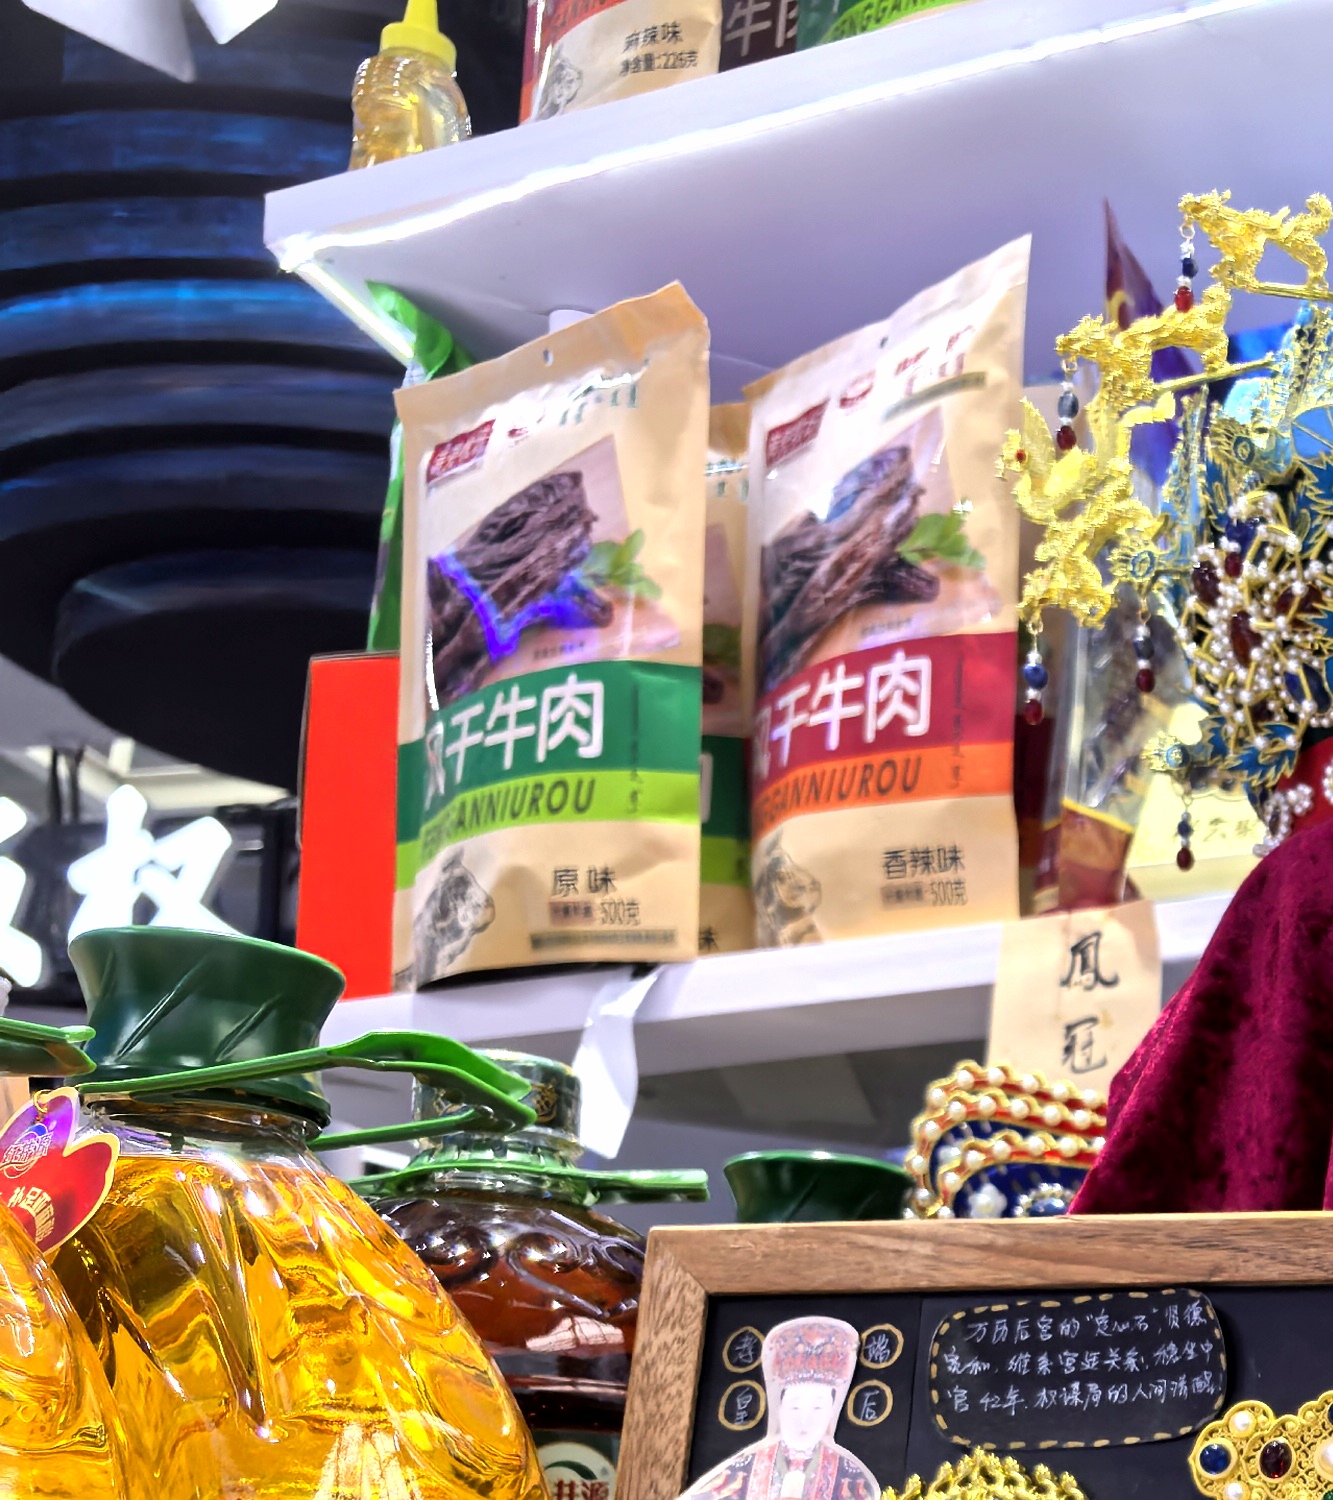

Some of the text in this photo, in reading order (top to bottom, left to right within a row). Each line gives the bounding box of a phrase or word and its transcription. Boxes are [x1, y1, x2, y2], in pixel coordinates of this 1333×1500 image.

[883, 844, 965, 879] 香辣味
[552, 866, 616, 897] 原味
[735, 1388, 880, 1425] 皇 后
